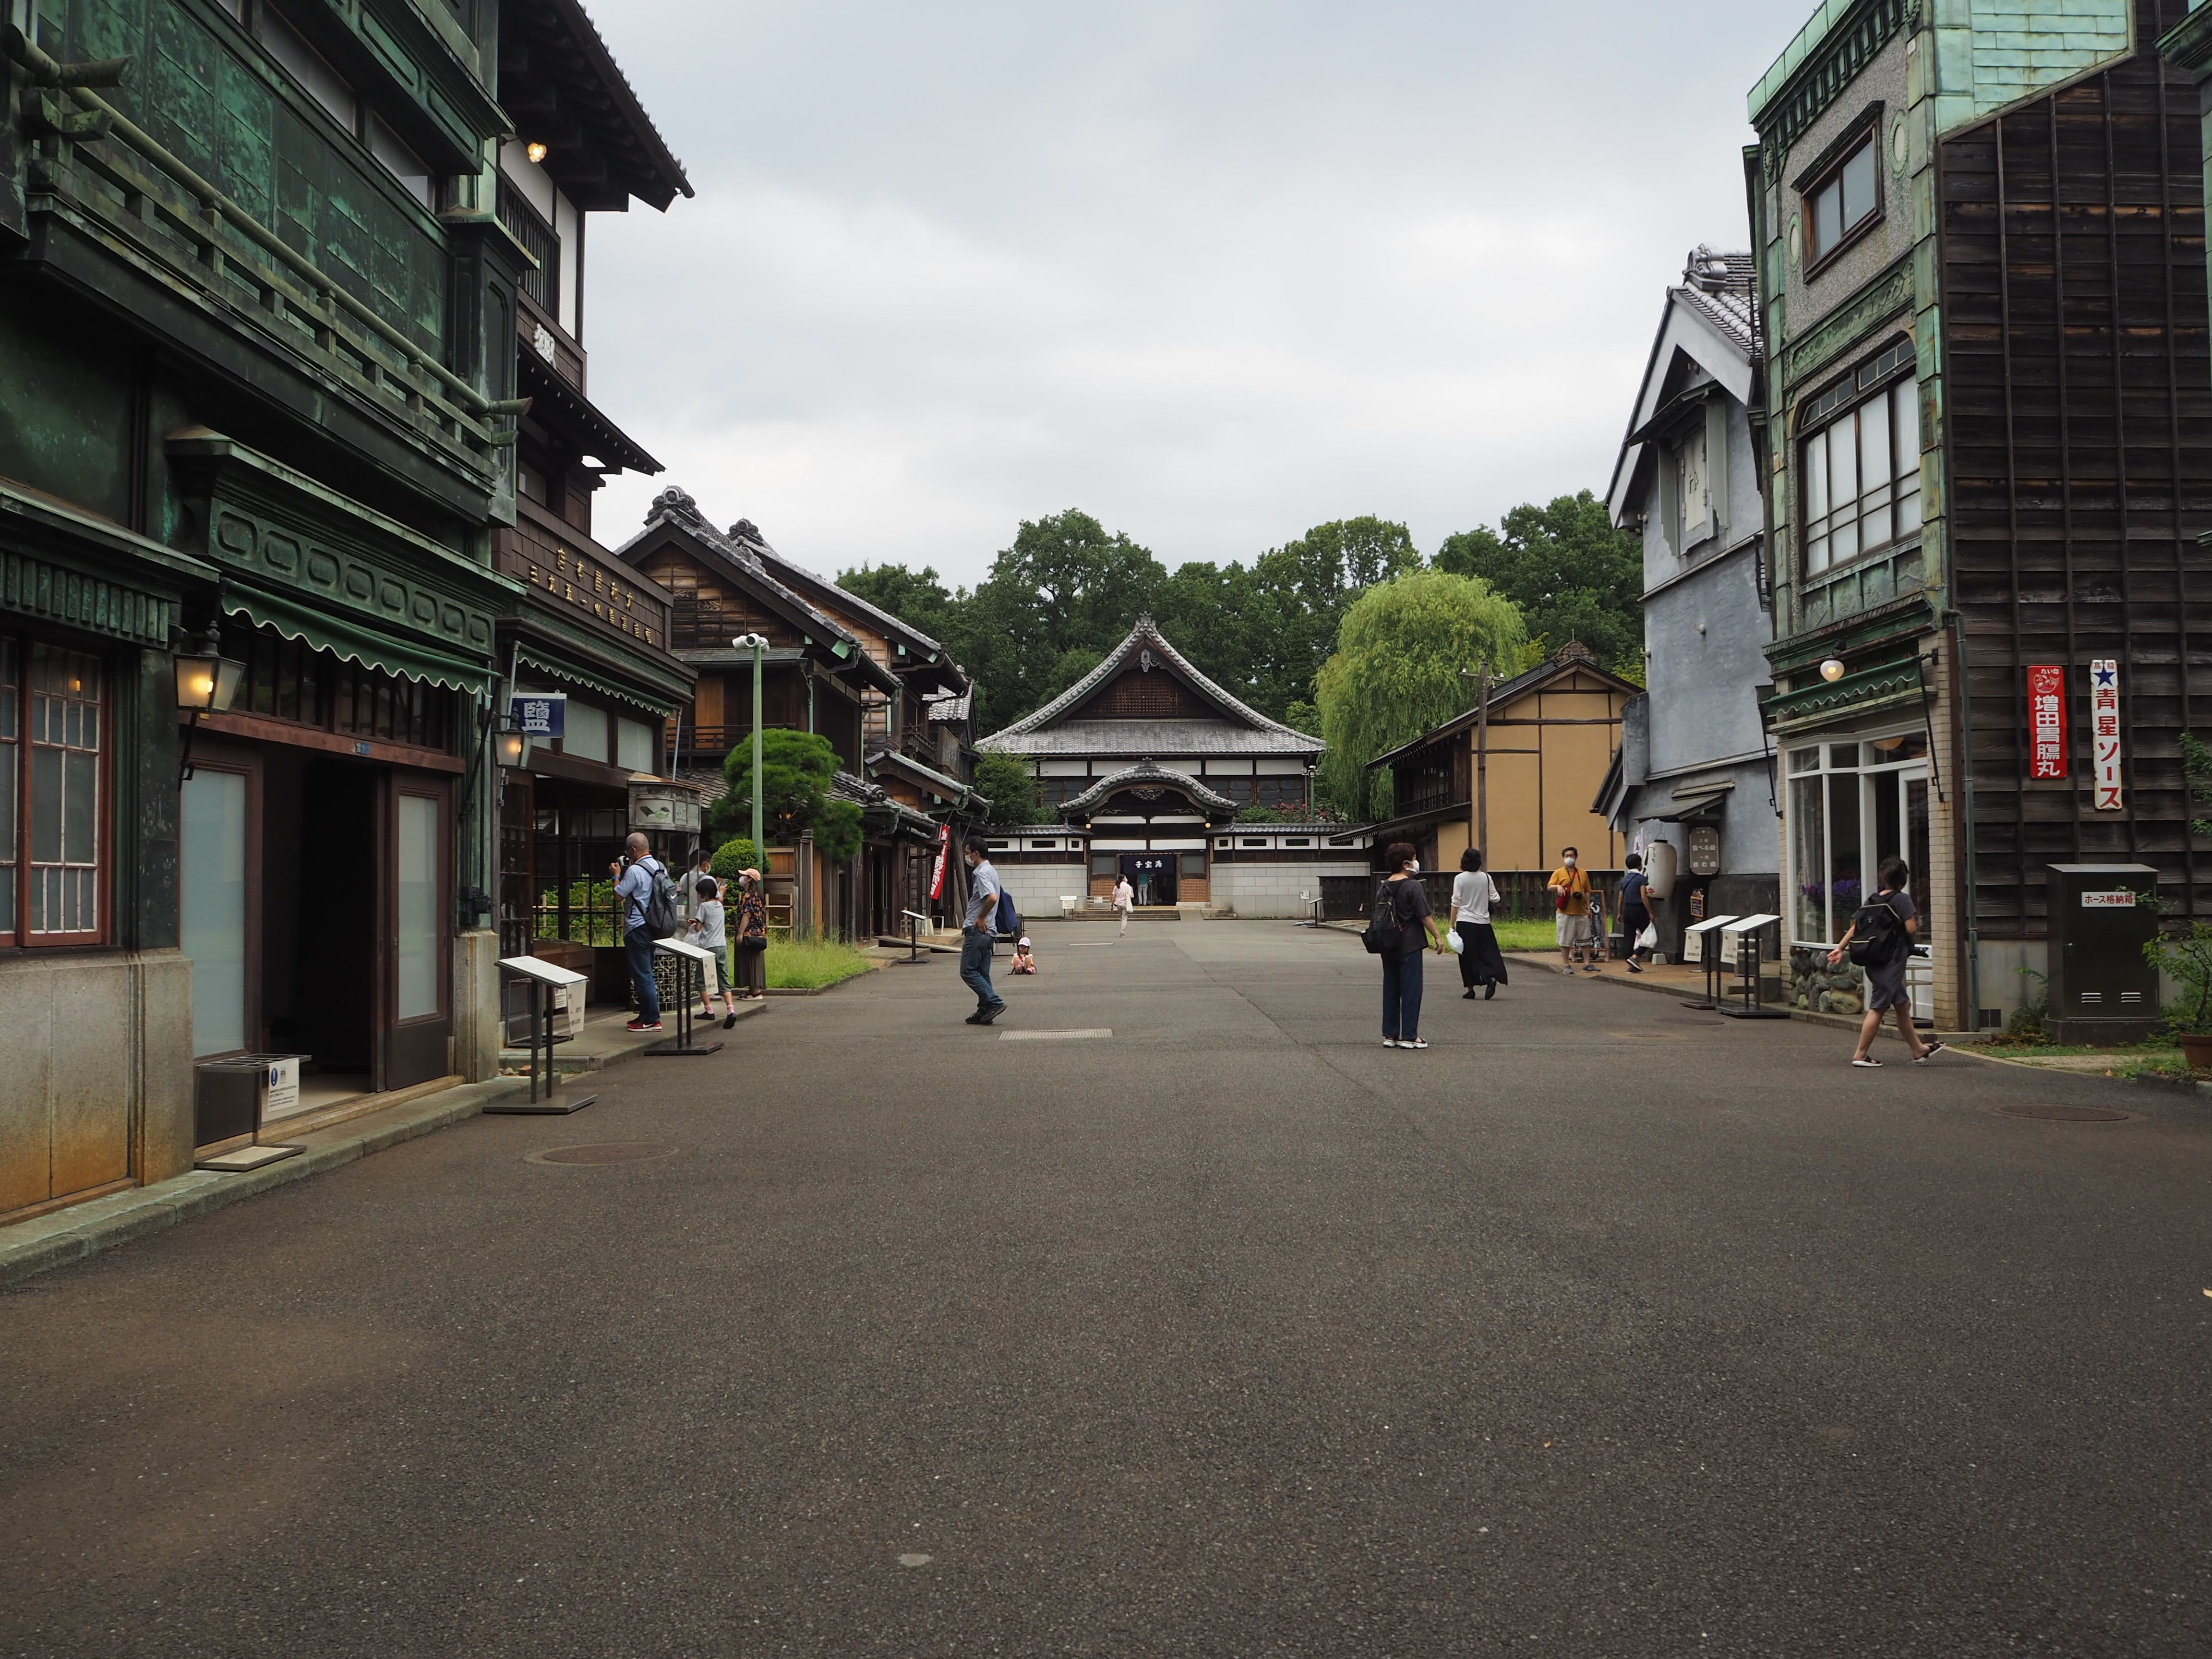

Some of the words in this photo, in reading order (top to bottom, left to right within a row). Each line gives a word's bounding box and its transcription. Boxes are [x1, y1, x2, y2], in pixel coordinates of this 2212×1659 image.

[2095, 688, 2120, 808] 青星ソース
[1135, 860, 1163, 868] 子宝湯
[2085, 894, 2133, 904] ホース格納箱
